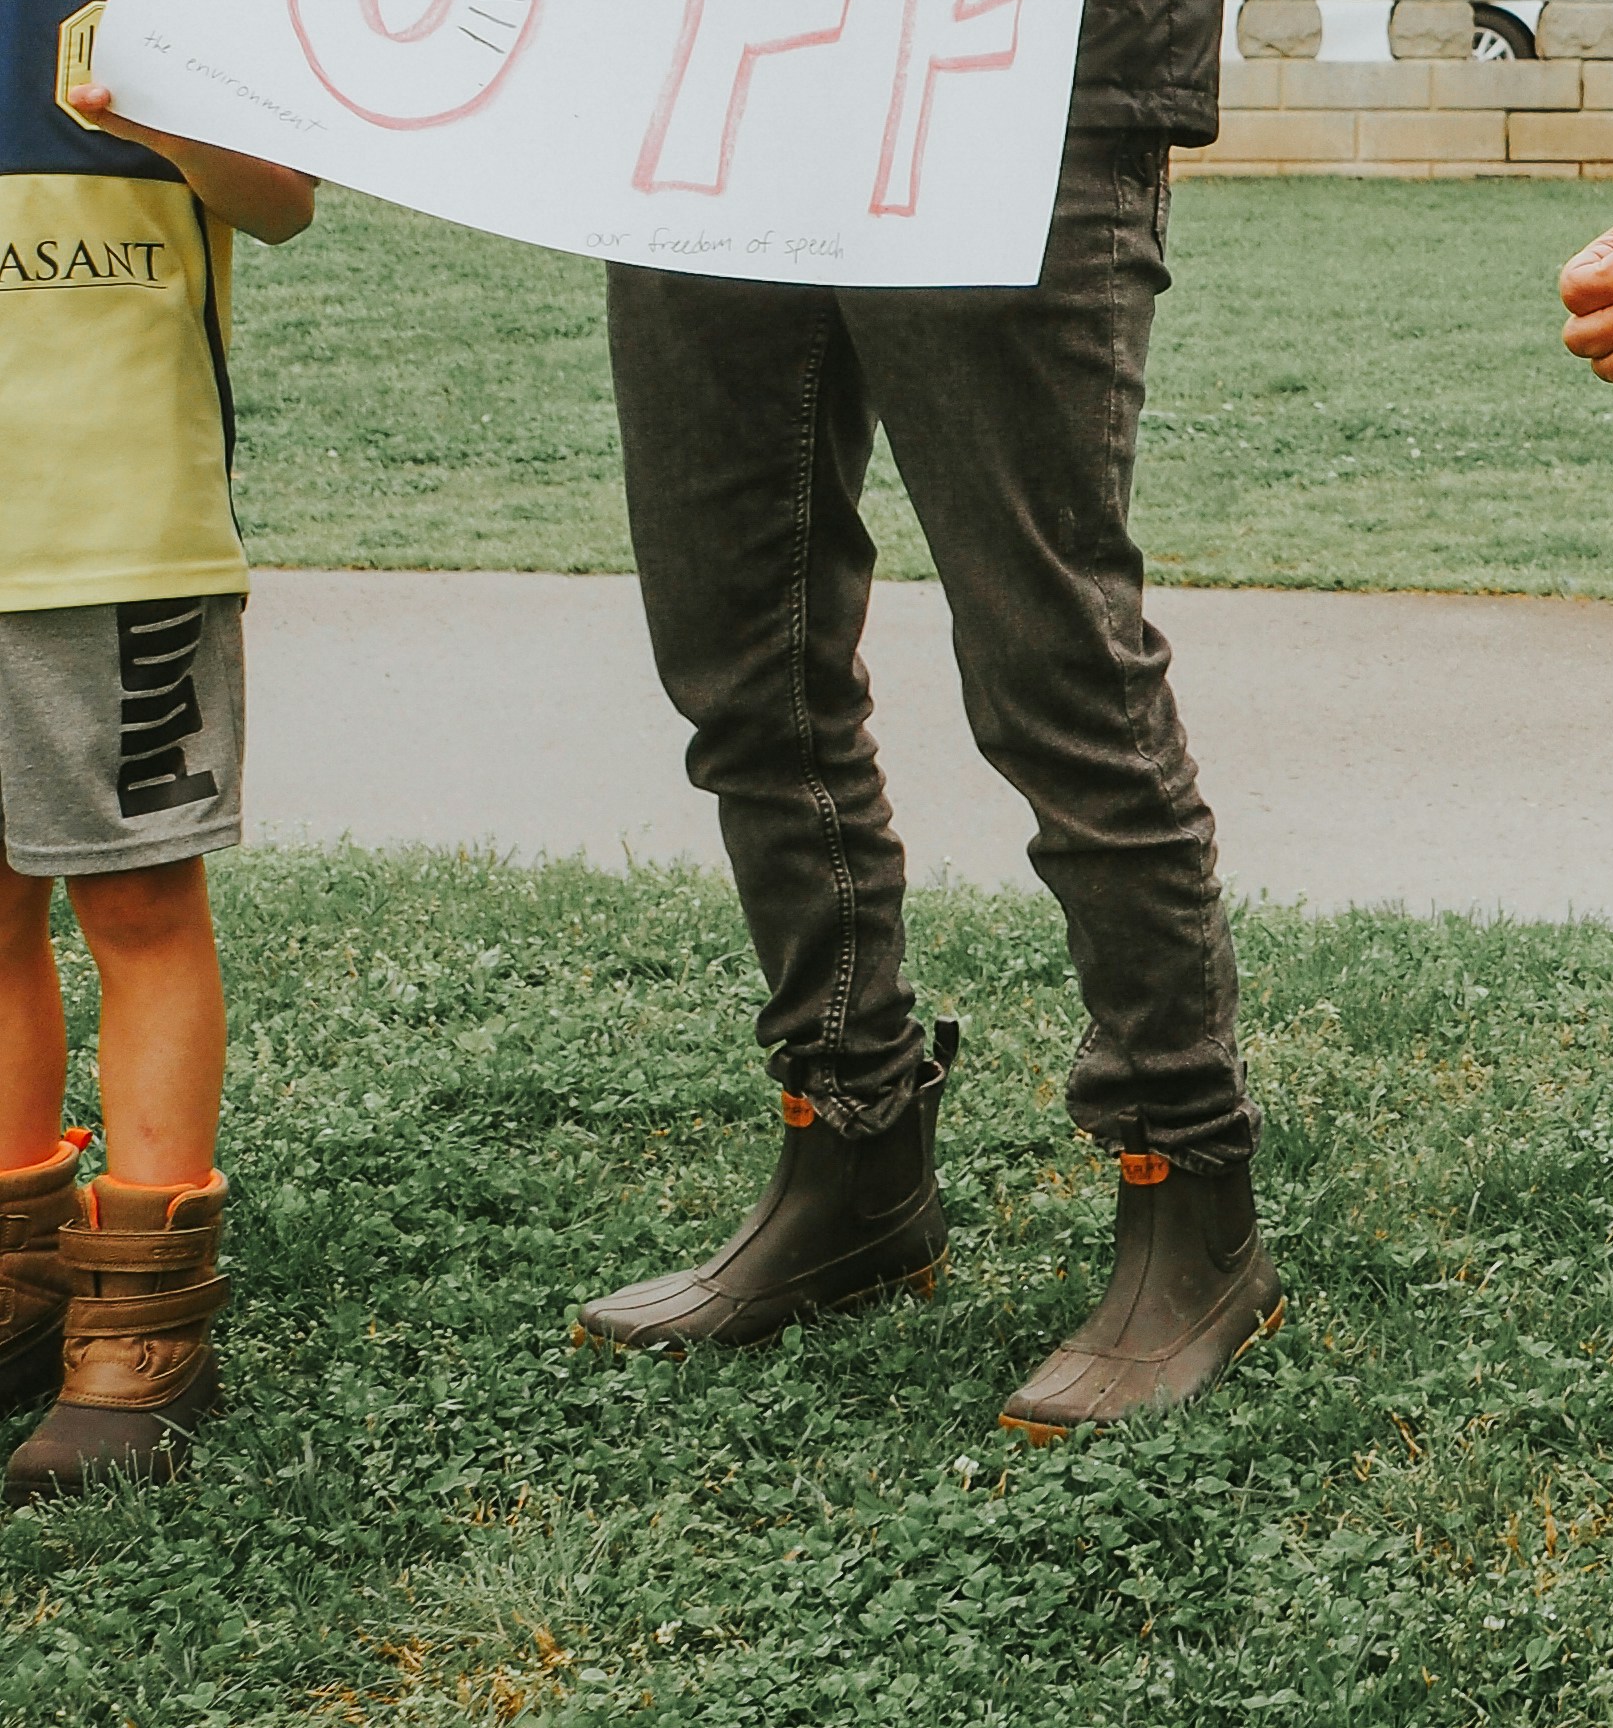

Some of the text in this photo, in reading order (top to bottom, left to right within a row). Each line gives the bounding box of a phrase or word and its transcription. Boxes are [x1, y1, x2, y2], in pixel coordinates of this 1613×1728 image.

[143, 29, 329, 132] the environment
[0, 239, 165, 282] ASANT
[648, 227, 733, 256] freedom
[745, 229, 777, 255] of
[783, 232, 845, 264] speech
